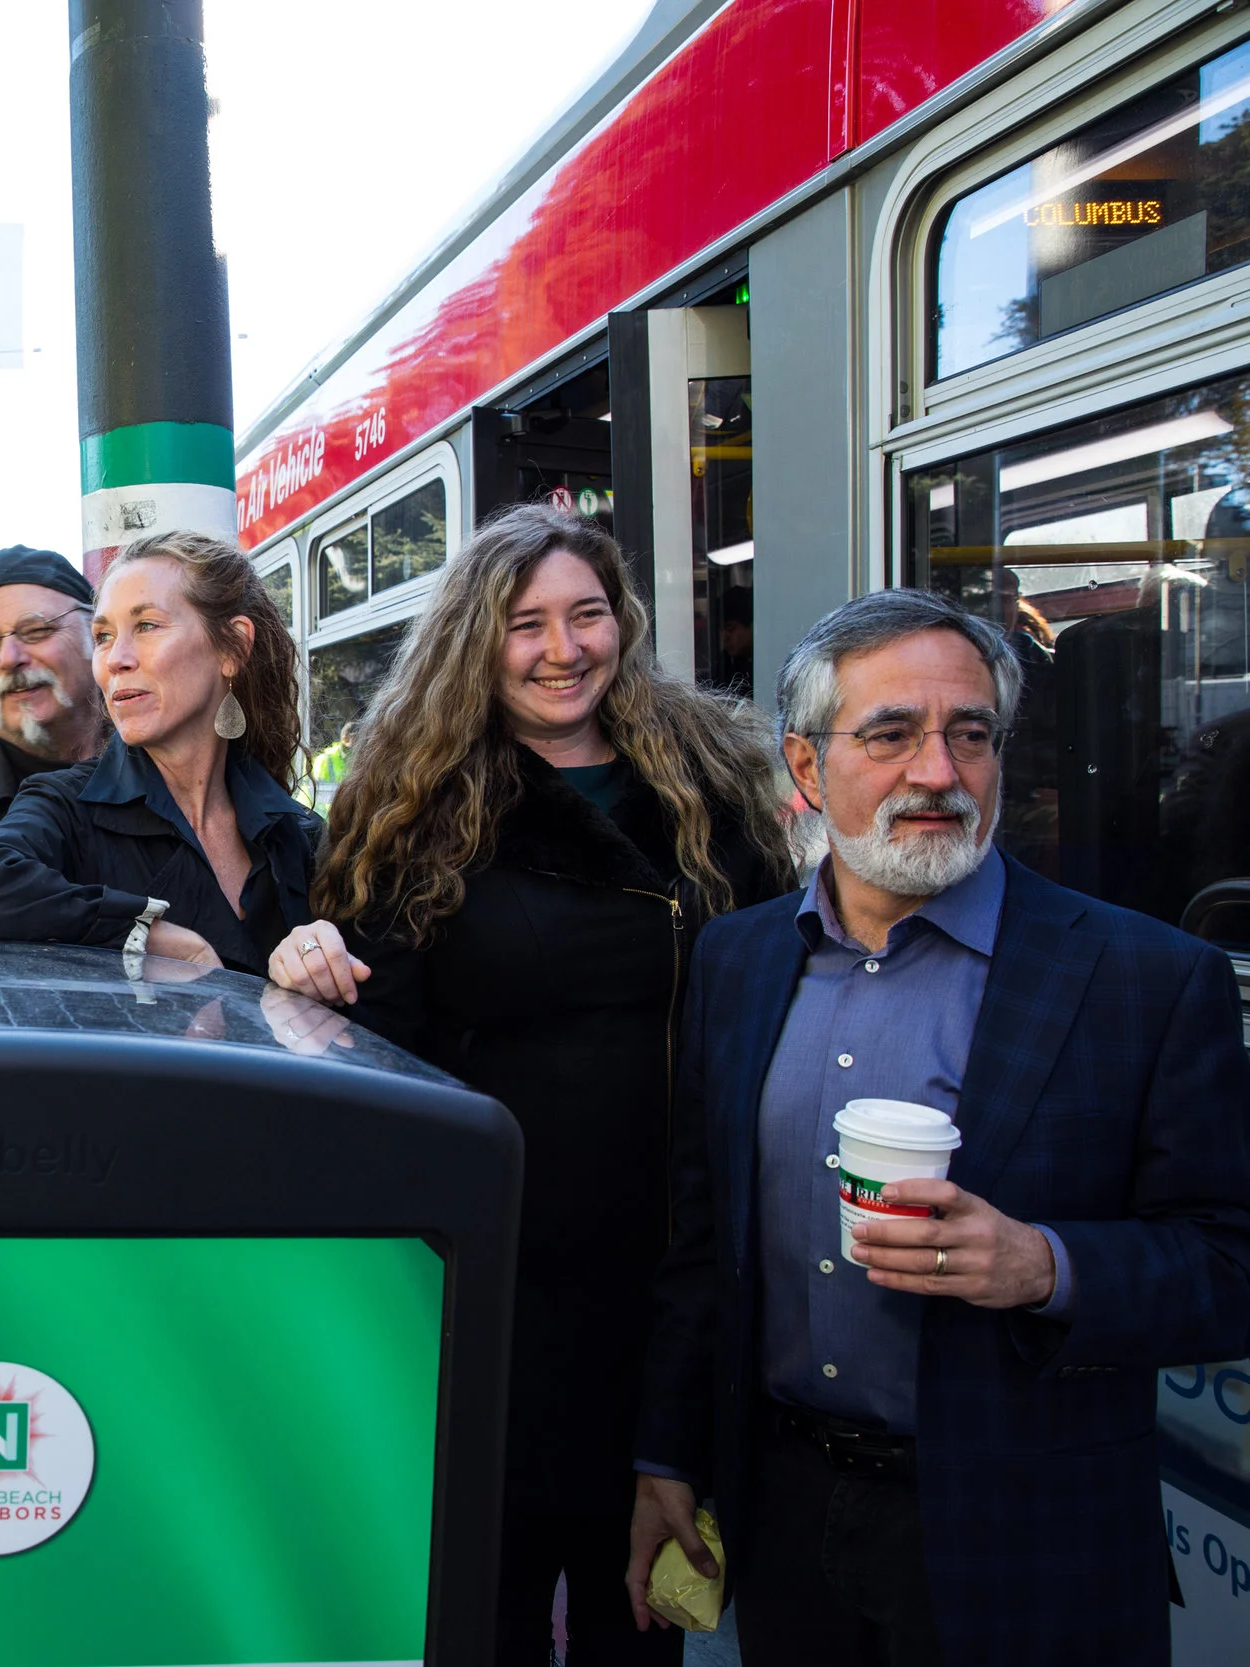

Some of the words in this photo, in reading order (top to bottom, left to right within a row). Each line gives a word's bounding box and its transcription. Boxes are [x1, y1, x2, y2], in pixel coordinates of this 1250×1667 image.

[1023, 199, 1162, 227] COLUMBUS
[354, 406, 386, 461] 5746
[245, 473, 268, 528] Air
[268, 423, 325, 510] Vehicle
